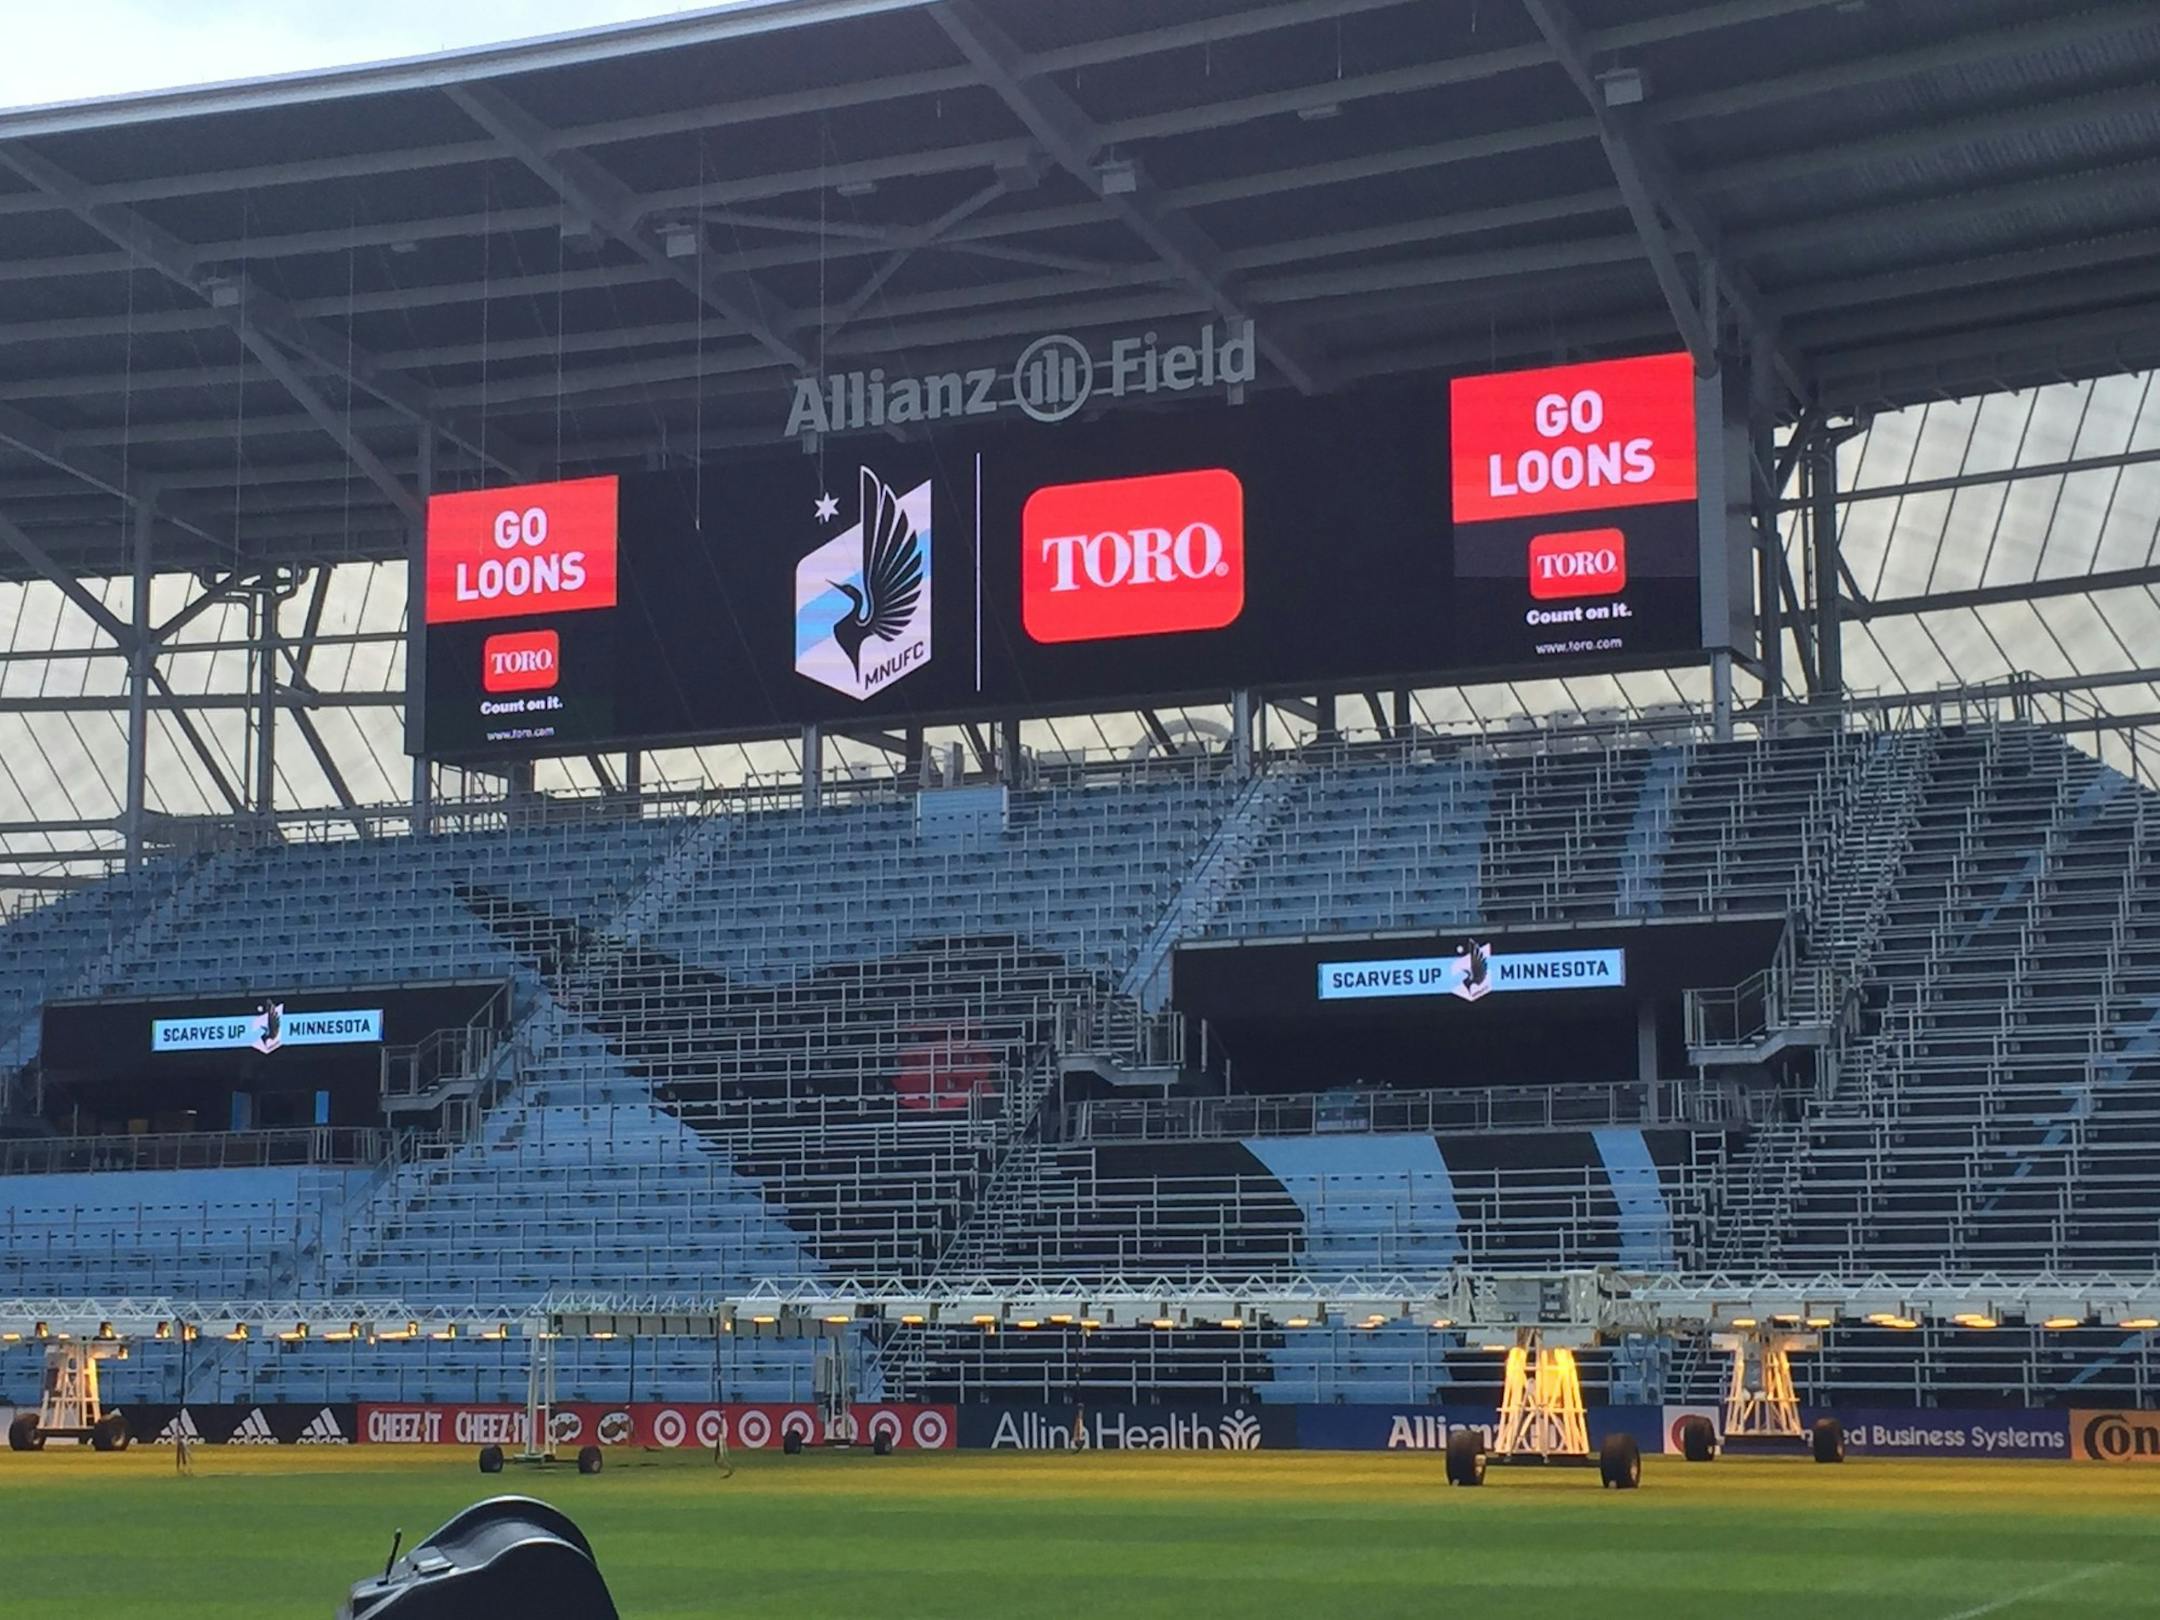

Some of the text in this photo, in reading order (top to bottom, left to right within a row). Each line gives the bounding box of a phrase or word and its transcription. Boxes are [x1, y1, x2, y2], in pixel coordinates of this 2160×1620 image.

[784, 319, 1256, 437] Allianz Field
[1536, 389, 1604, 438] GO
[1489, 438, 1656, 497] LOONS
[494, 507, 548, 550] GO
[456, 551, 586, 602] LOONS
[1537, 548, 1618, 579] TORO
[1526, 602, 1632, 625] Count on it.
[1535, 638, 1623, 654] www.toro.com
[491, 648, 554, 675] TORO
[864, 640, 925, 690] MNUFC
[480, 695, 563, 715] Count on it.
[486, 727, 555, 741] www.toro.com
[1332, 959, 1609, 989] SCARVES UP MINNESOTA
[163, 1018, 371, 1043] SCARVES UP MINNESOTA
[1096, 1411, 1215, 1450] Health
[1872, 1425, 1966, 1447] Business
[1970, 1425, 2065, 1452] Systems
